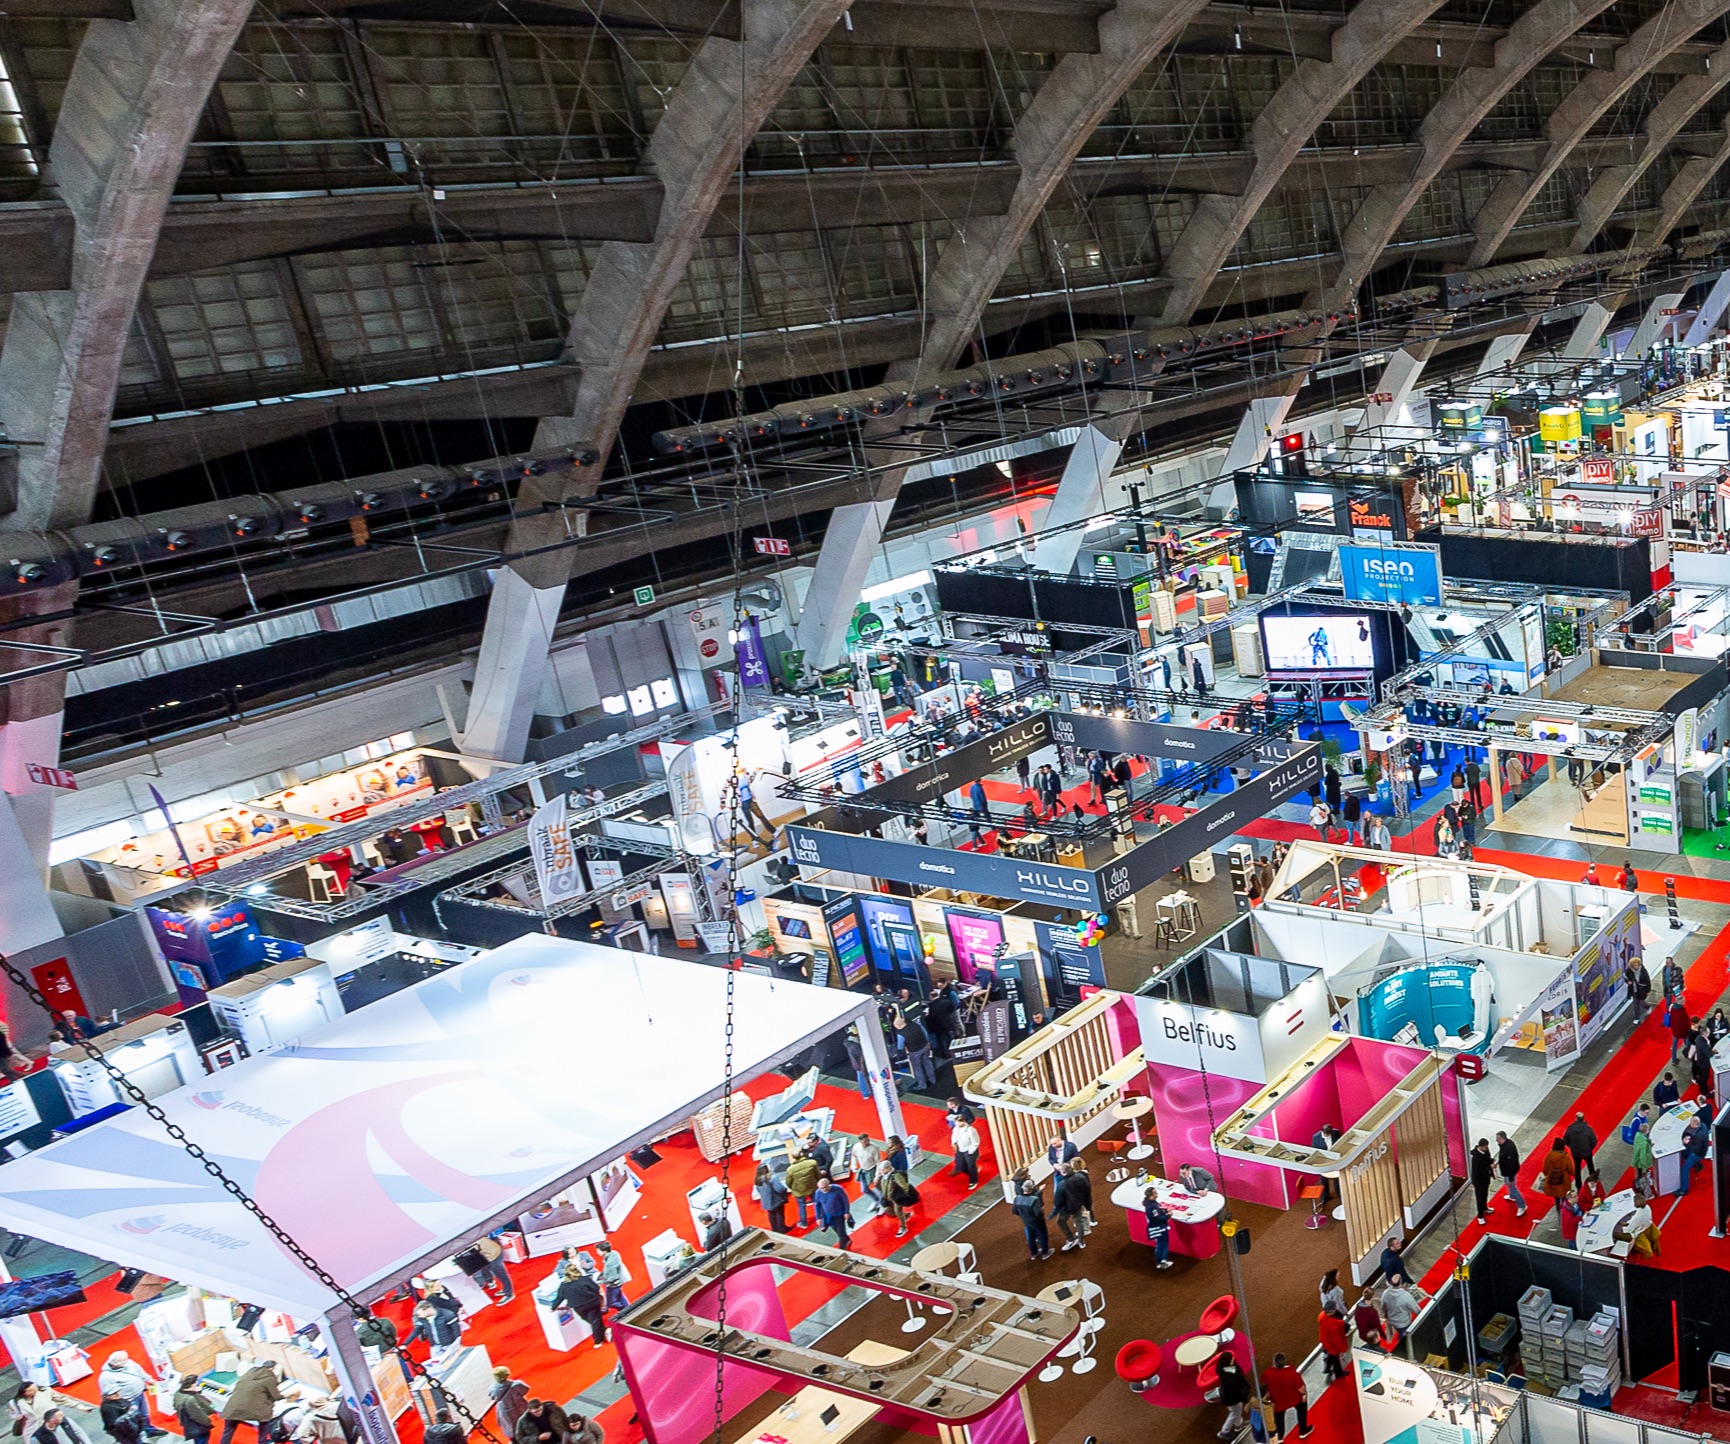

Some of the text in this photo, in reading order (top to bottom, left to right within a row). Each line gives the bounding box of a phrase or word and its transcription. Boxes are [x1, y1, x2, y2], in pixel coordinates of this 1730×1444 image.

[1588, 464, 1608, 476] DIY
[1351, 512, 1392, 528] Franck
[1635, 512, 1659, 527] DIY
[1636, 526, 1660, 536] demo
[708, 619, 716, 628] A
[701, 643, 718, 654] STOP
[1058, 720, 1073, 733] duo
[989, 721, 1046, 756] XILLO
[1164, 738, 1196, 749] domotica
[1268, 754, 1318, 792] XILLO
[916, 772, 950, 791] domotica
[1206, 810, 1236, 832] domotica
[548, 820, 573, 871] SAFE
[799, 836, 817, 851] duo
[919, 861, 956, 875] domotica
[1111, 866, 1129, 885] duo
[1016, 870, 1090, 893] XILLO
[627, 889, 649, 903] SAFE
[1104, 878, 1131, 902] tecno
[996, 1008, 1007, 1037] PICARD
[1162, 1017, 1237, 1052] Belfius
[1390, 1386, 1412, 1398] YOUR
[1391, 1395, 1415, 1407] HOME
